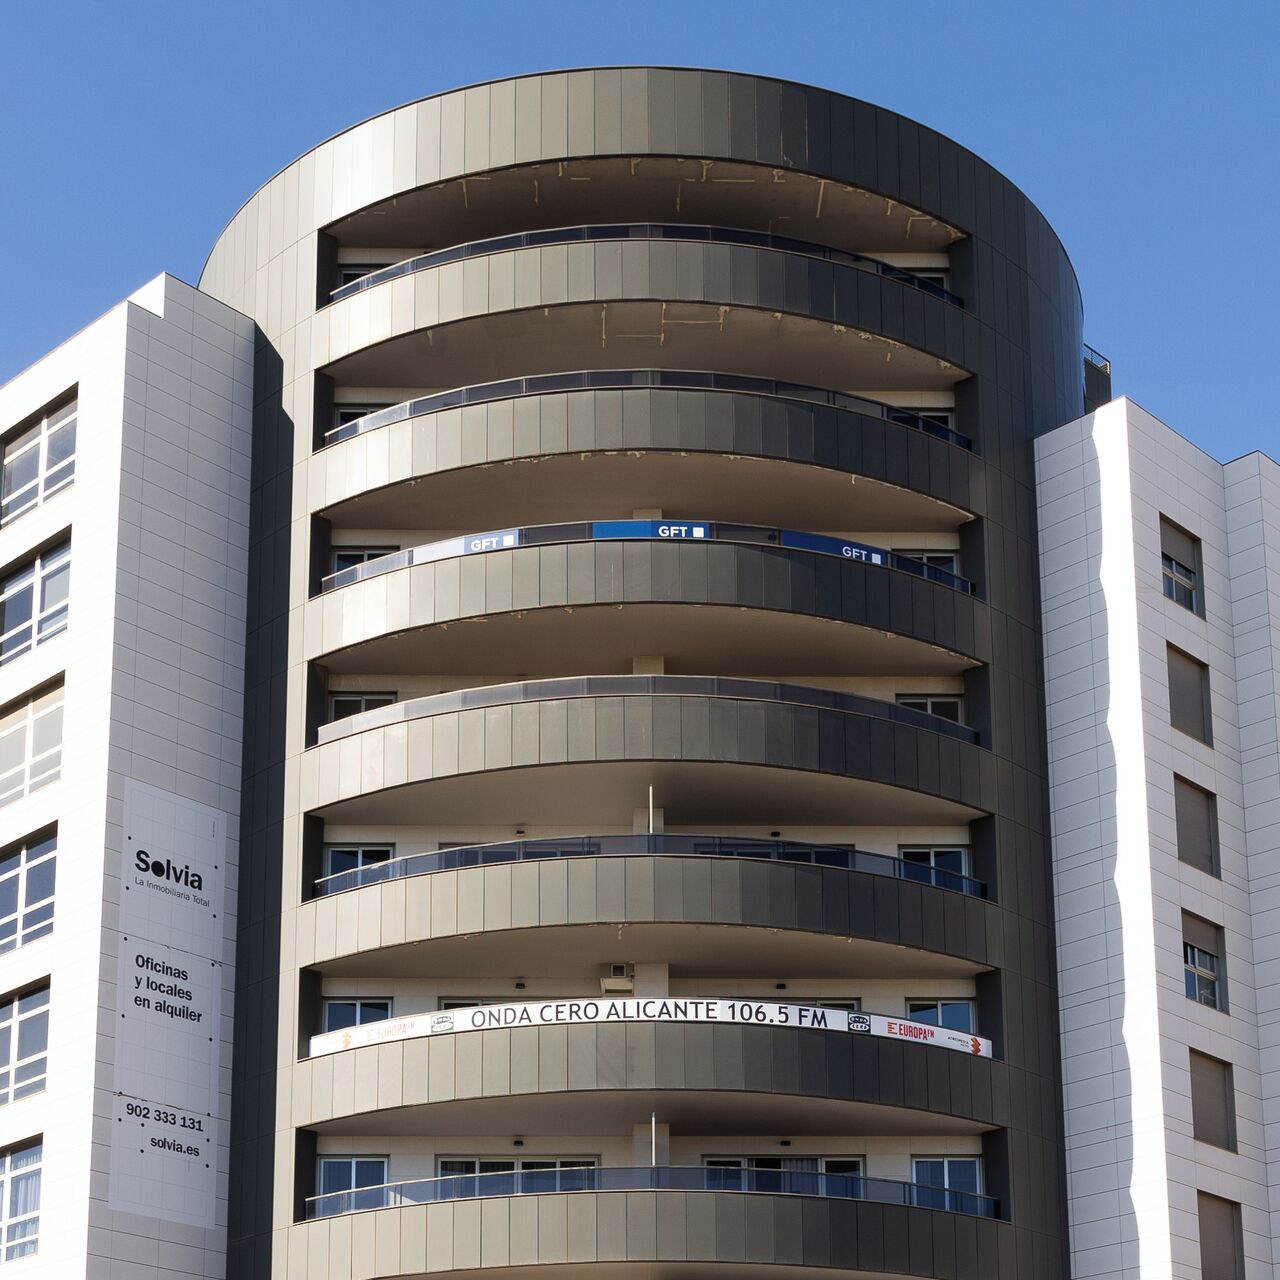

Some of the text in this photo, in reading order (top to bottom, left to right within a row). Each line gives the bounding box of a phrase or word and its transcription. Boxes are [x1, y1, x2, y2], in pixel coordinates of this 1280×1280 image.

[471, 537, 499, 551] GFT
[658, 526, 688, 537] GFT
[842, 546, 867, 560] GFT
[135, 850, 203, 891] Solvia
[135, 876, 210, 907] La Inmobiliaria Total
[135, 954, 188, 981] Oficinas
[135, 976, 193, 1001] y locales
[134, 995, 202, 1022] en alquiler
[471, 1001, 828, 1028] ONDA CERO ALICANTE 106.5 FM
[899, 1023, 928, 1041] EUROPA
[126, 1103, 204, 1132] 902 333 131
[150, 1137, 200, 1157] solvia.es
